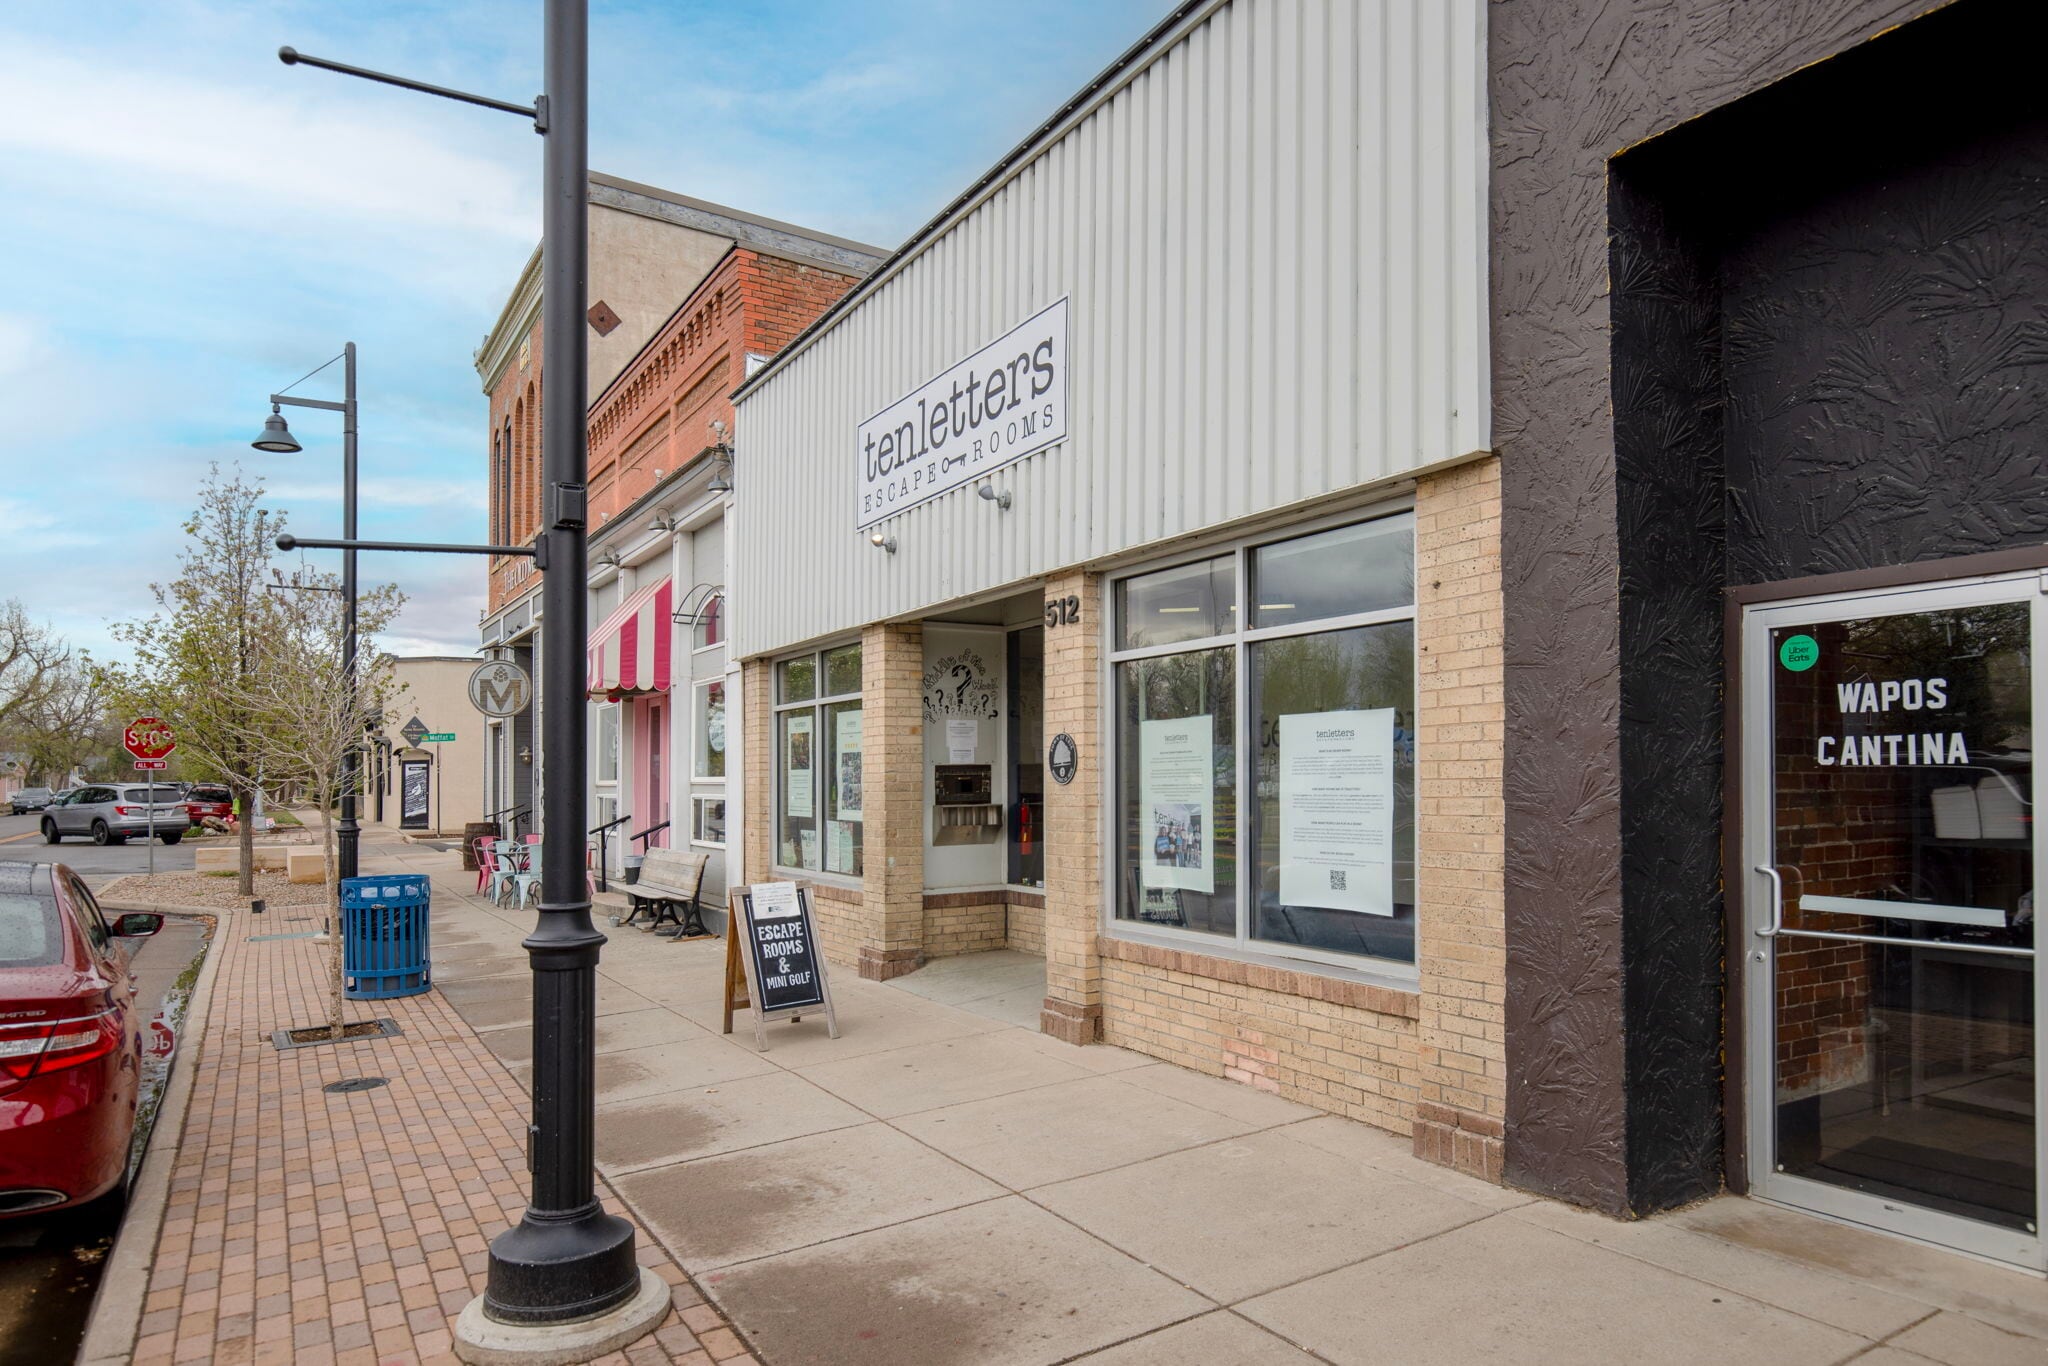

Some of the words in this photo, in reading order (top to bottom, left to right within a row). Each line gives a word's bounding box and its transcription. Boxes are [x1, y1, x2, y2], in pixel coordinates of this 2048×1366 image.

[864, 336, 1054, 483] tenletters
[864, 461, 936, 514] ESCAPE
[972, 403, 1054, 463] ROOMS
[1045, 594, 1080, 628] 512
[1788, 646, 1810, 654] Uber
[478, 678, 523, 713] M
[1837, 677, 1948, 714] WAPOS
[1316, 728, 1355, 738] tenletters
[1817, 731, 1969, 767] CANTINA
[757, 921, 804, 941] ESCAPE
[762, 939, 804, 959] ROOMS
[778, 957, 791, 974] &
[766, 976, 787, 990] MINI
[789, 971, 811, 987] GOLF
